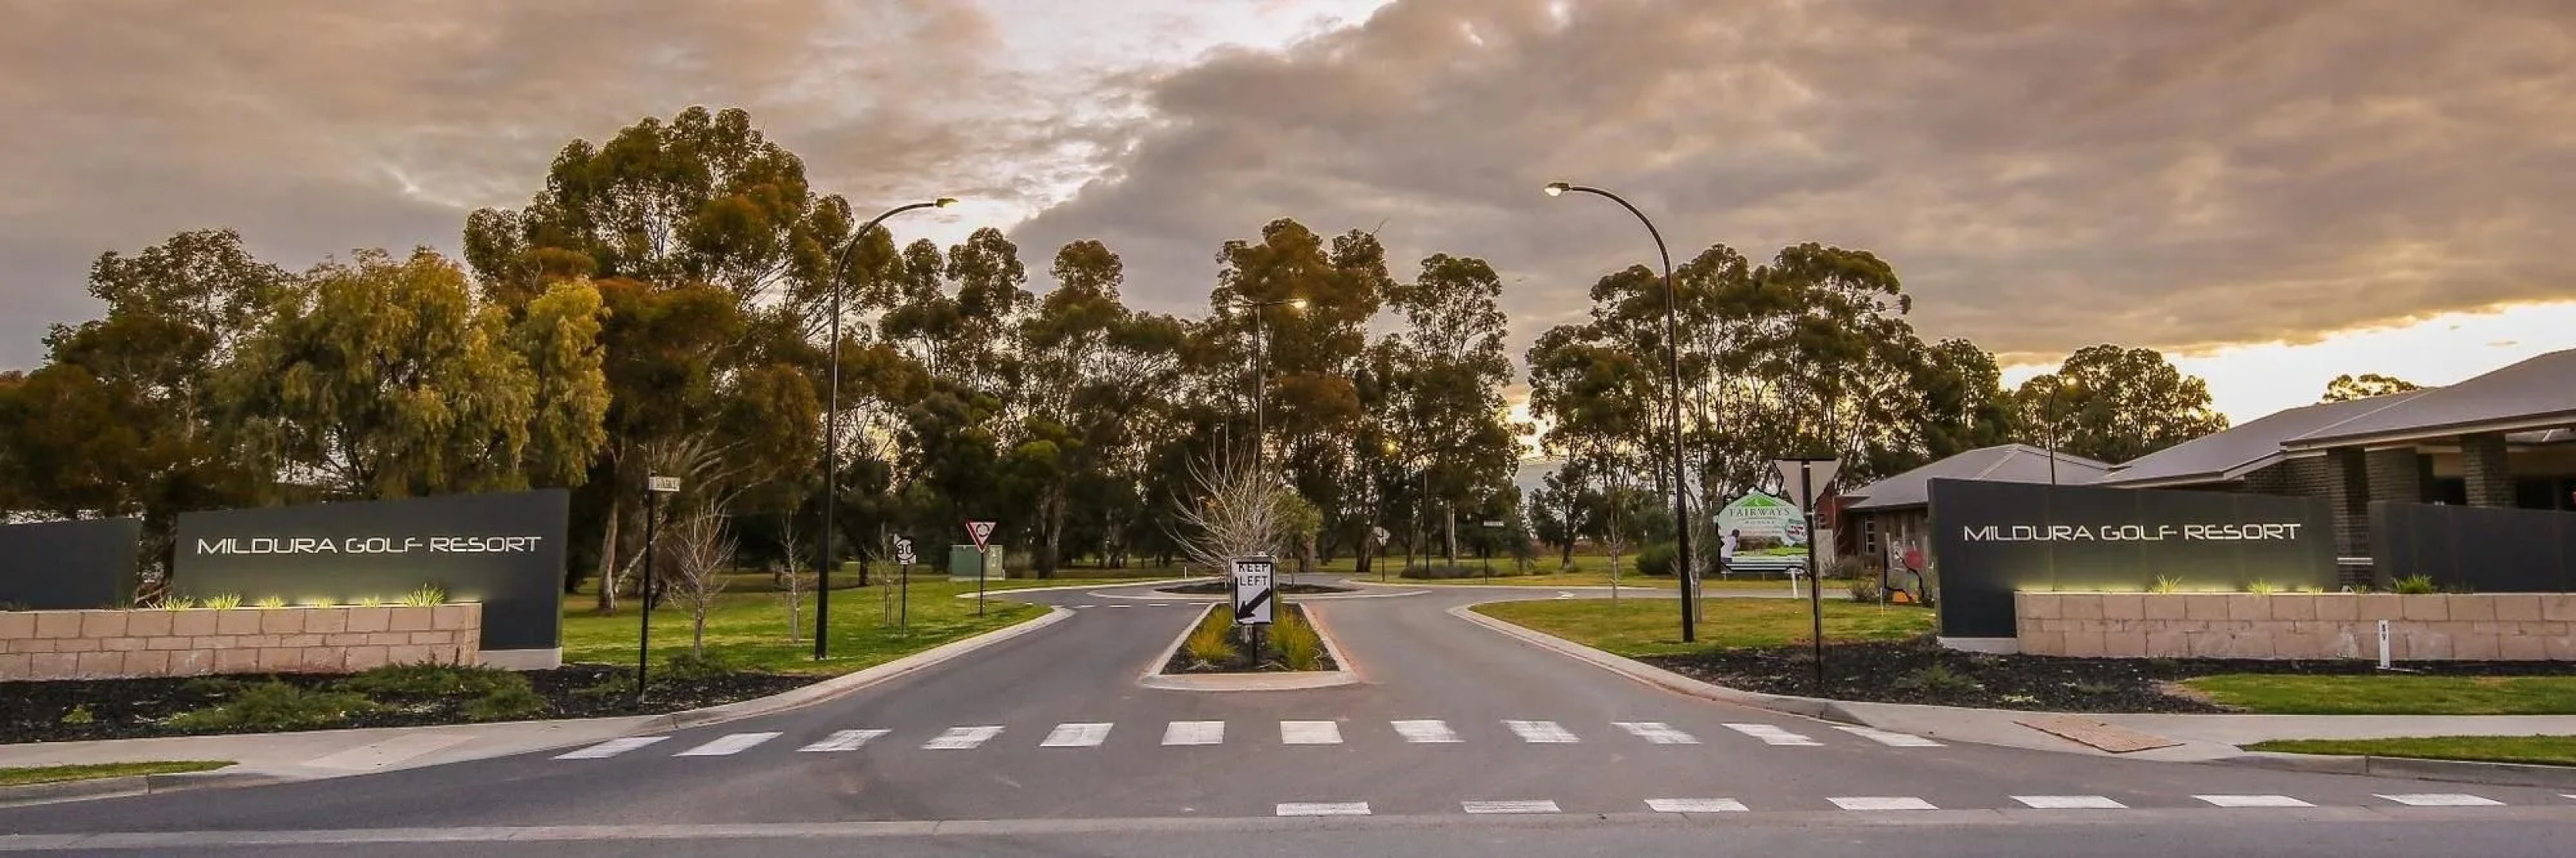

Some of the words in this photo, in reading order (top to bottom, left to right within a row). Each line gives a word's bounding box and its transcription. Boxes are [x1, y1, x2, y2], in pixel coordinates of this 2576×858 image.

[1963, 524, 2095, 542] MILDURA
[2100, 524, 2177, 541] GOLF
[2183, 523, 2301, 540] RESORT
[196, 538, 338, 555] MILDURA
[345, 537, 423, 554] GOLF
[429, 535, 542, 552] RESORT
[1238, 563, 1269, 573] KEEP
[1239, 575, 1269, 586] LEFT
